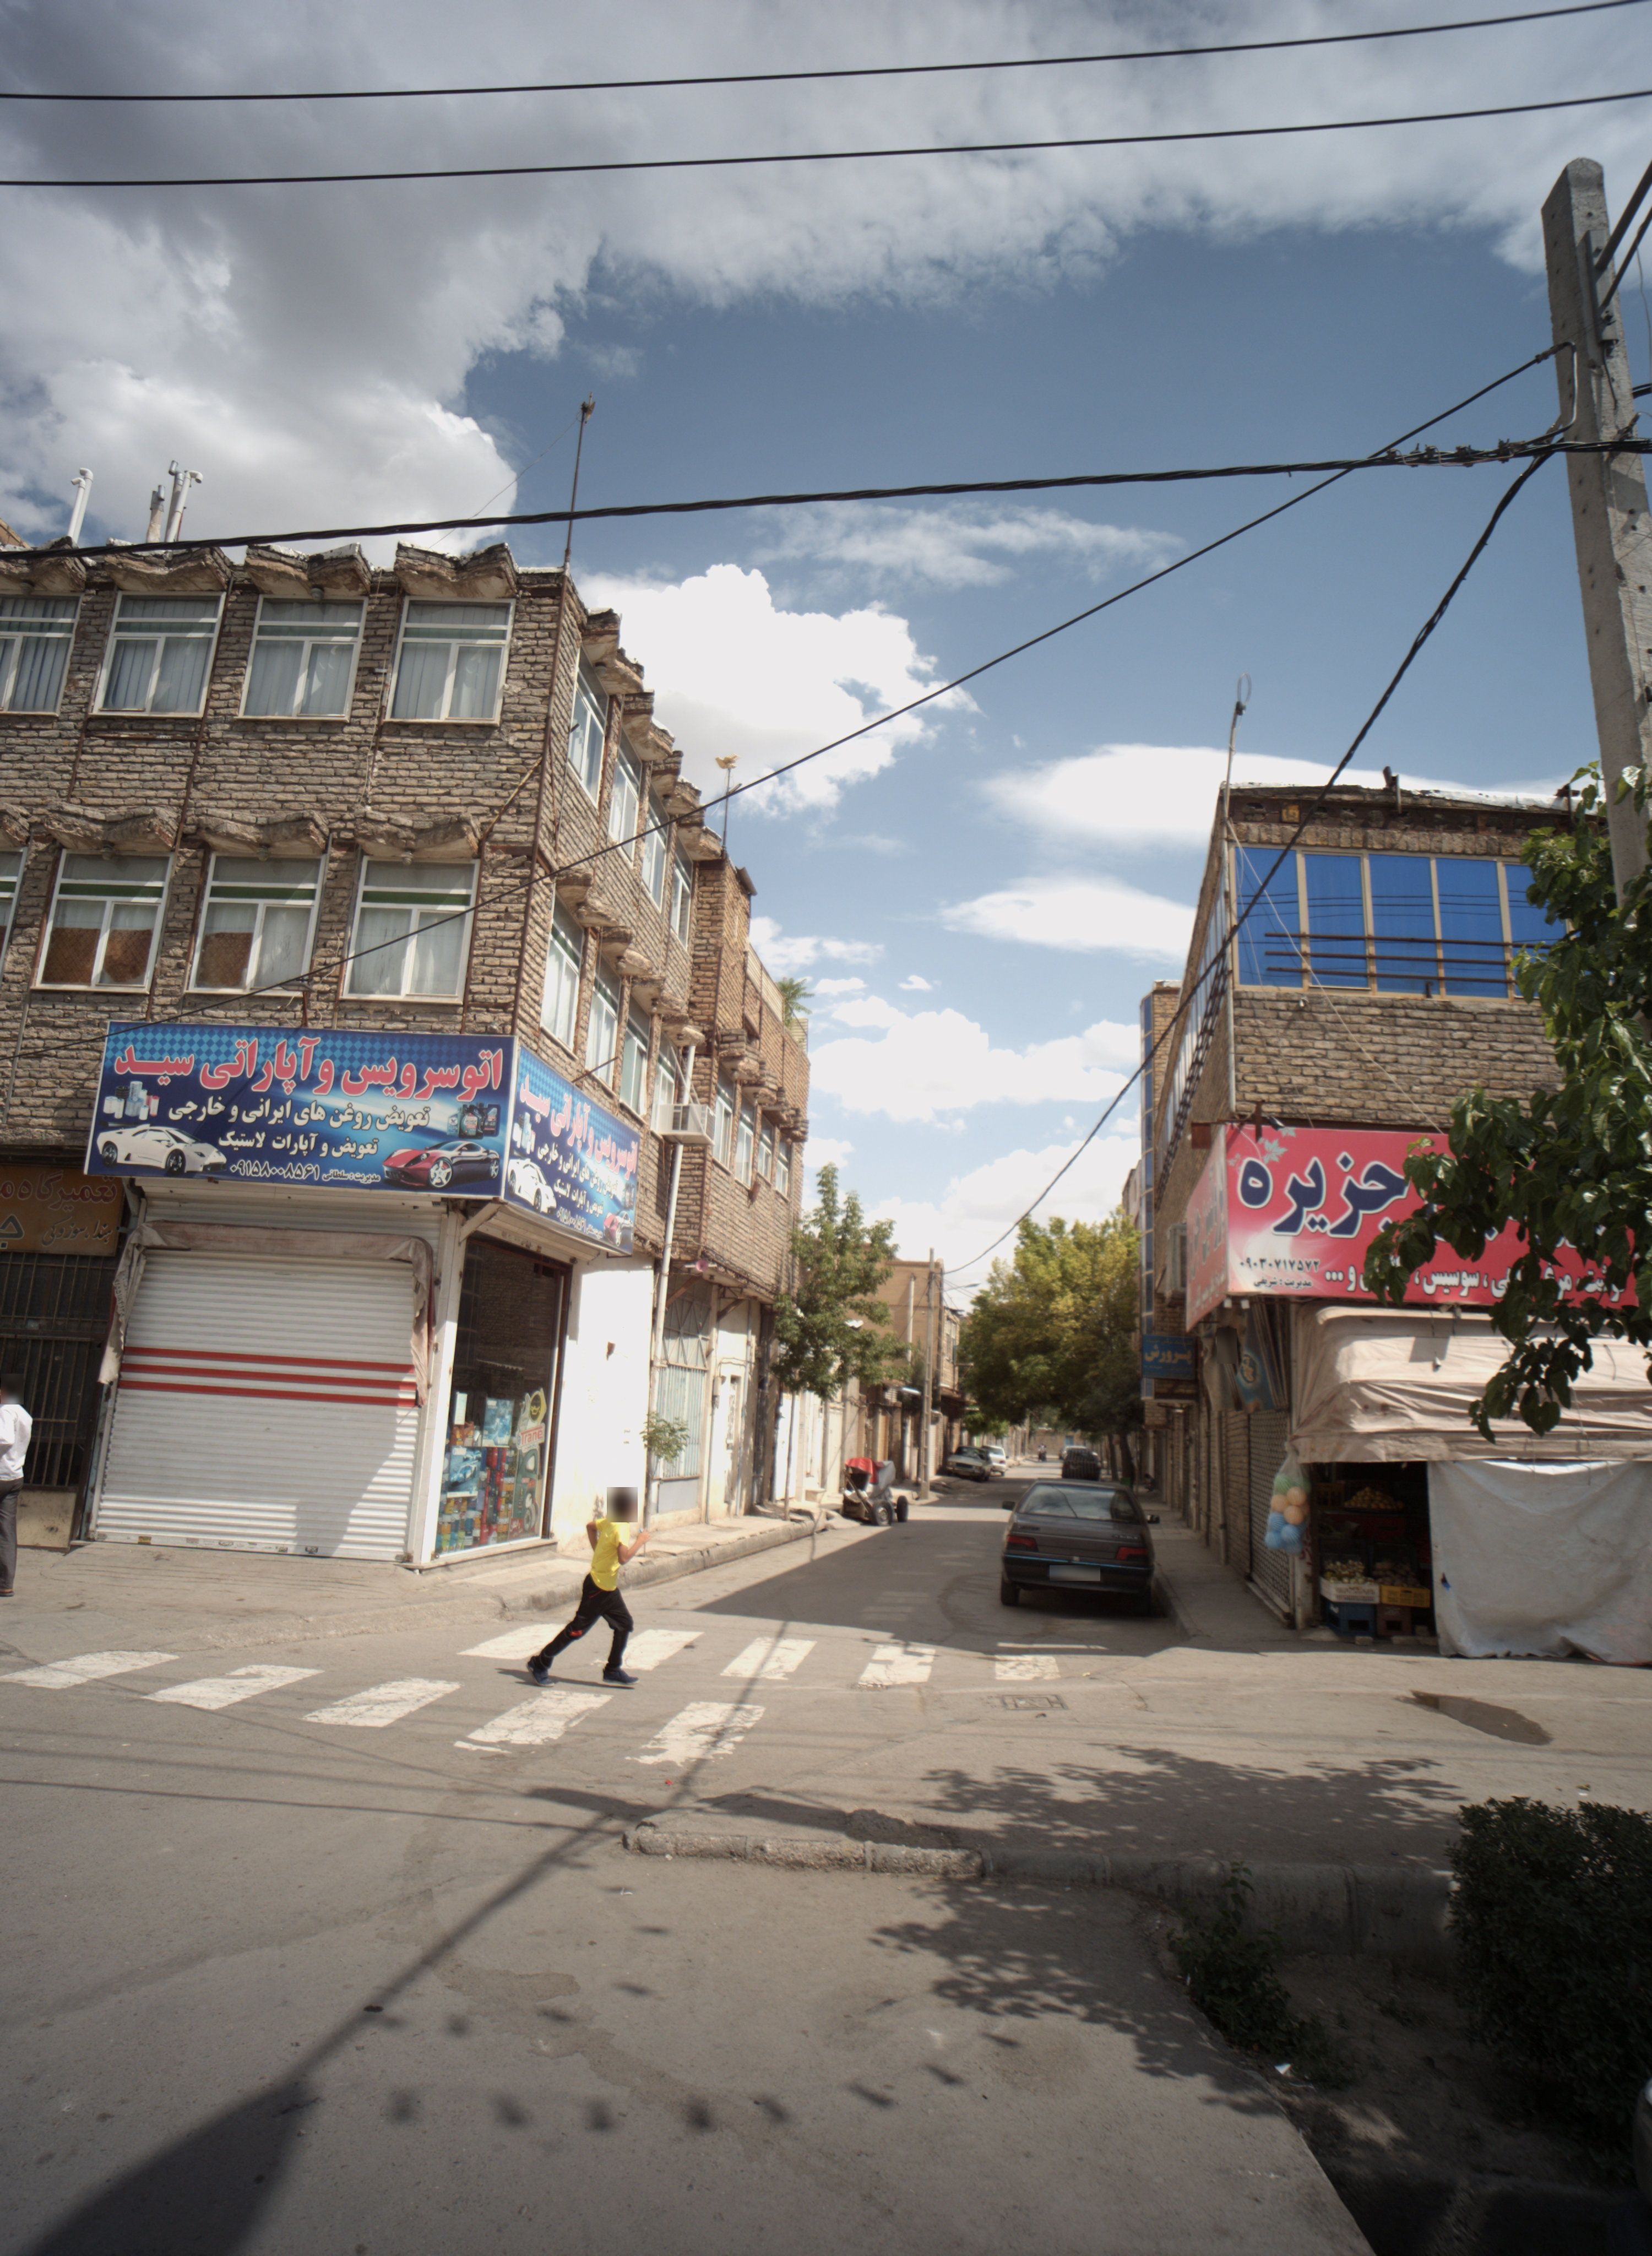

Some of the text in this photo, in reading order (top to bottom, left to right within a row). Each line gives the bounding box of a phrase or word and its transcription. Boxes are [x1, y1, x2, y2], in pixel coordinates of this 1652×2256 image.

[114, 1036, 503, 1102] اتوسرویس و آپاراتی سید
[168, 1096, 431, 1133] تعویض روغن های ایرانی و خارجی
[520, 1073, 551, 1124] سید
[218, 1130, 379, 1159] تعویض و آپارات لاستیک
[230, 1159, 320, 1181] ۰۹۱۵۸۰۰۸۵۶۱
[322, 1168, 349, 1181] سلطانی
[17, 1170, 118, 1212] تعمیرگاه
[1237, 1151, 1411, 1239] جزیره
